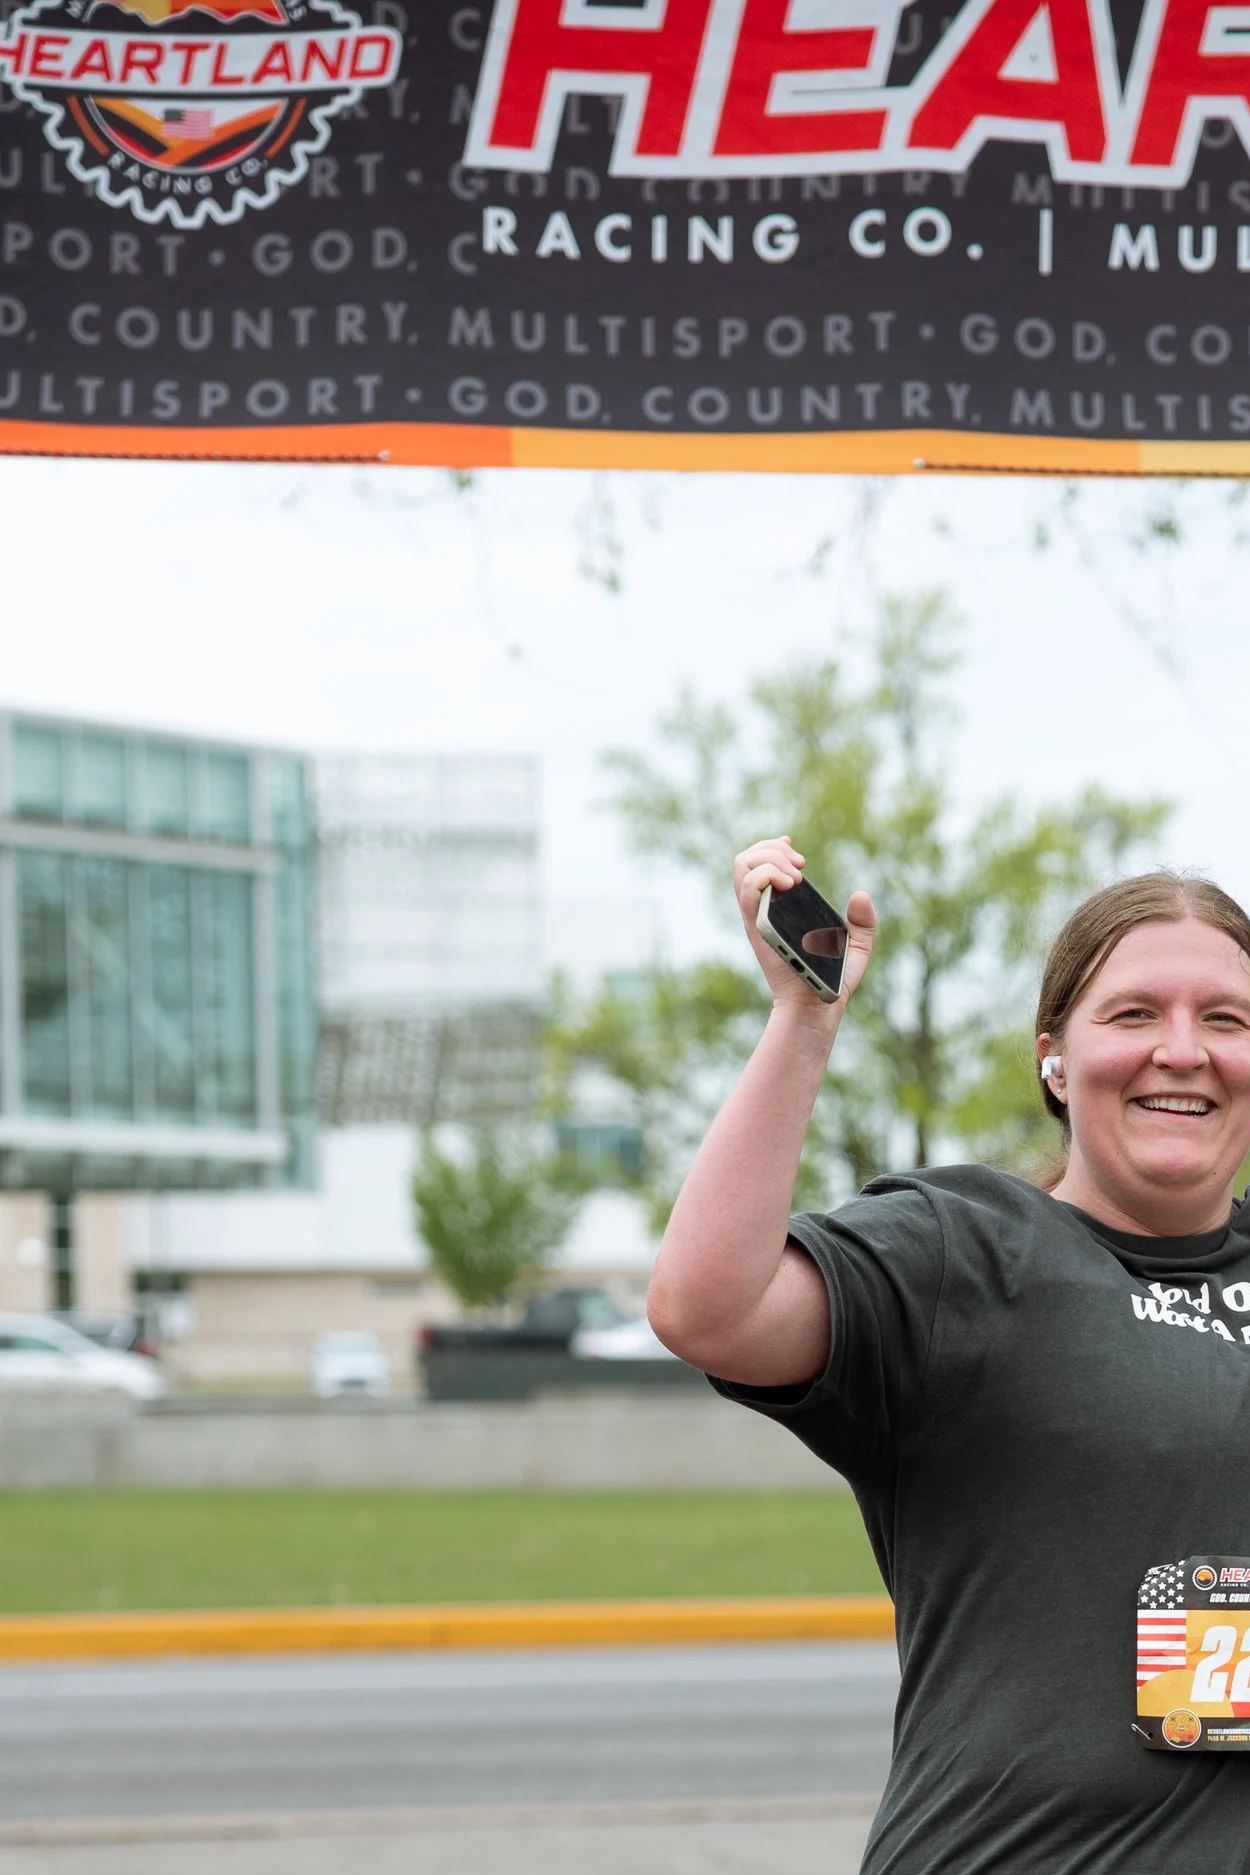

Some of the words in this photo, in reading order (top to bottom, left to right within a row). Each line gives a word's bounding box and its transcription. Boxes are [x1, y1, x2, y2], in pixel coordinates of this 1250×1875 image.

[0, 32, 394, 87] HEARTLAND
[108, 151, 213, 195] RACING
[481, 206, 800, 263] RACING
[848, 207, 984, 261] CO.
[447, 305, 896, 358] MULTISPORT
